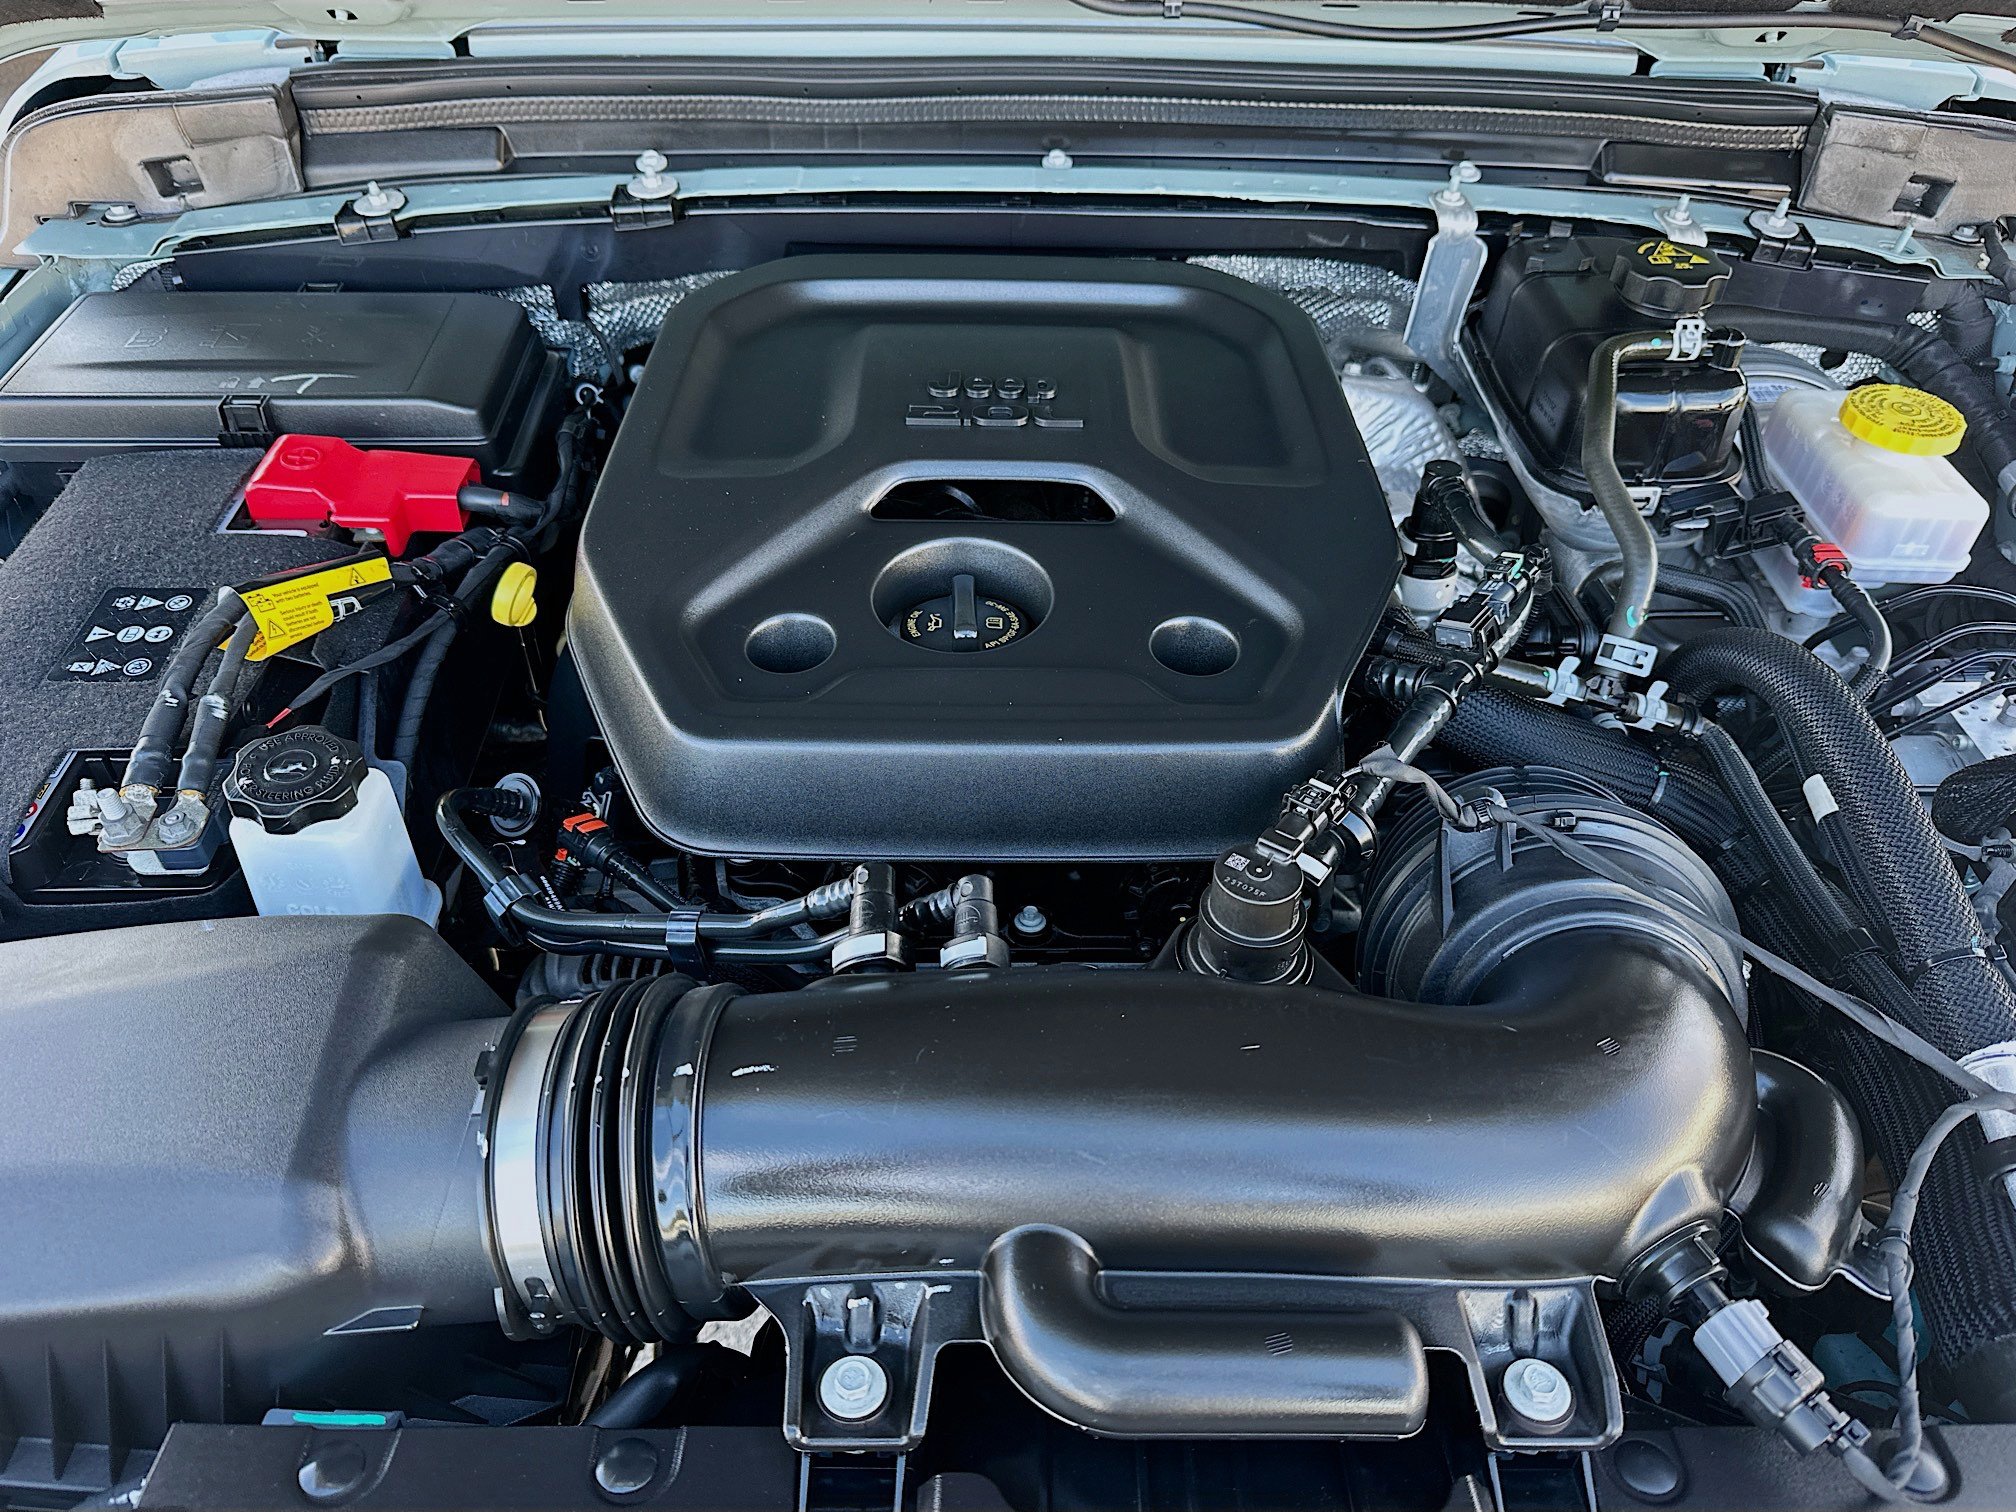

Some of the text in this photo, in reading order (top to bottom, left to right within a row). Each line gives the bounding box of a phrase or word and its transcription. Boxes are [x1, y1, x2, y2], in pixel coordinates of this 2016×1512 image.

[927, 369, 1058, 404] Jeep
[905, 404, 1084, 428] 2.0L
[906, 609, 924, 638] ENGINE OIL
[984, 640, 1001, 649] API
[259, 732, 340, 753] USE APPROVED
[255, 785, 314, 801] STEERING
[314, 764, 340, 790] FLUID
